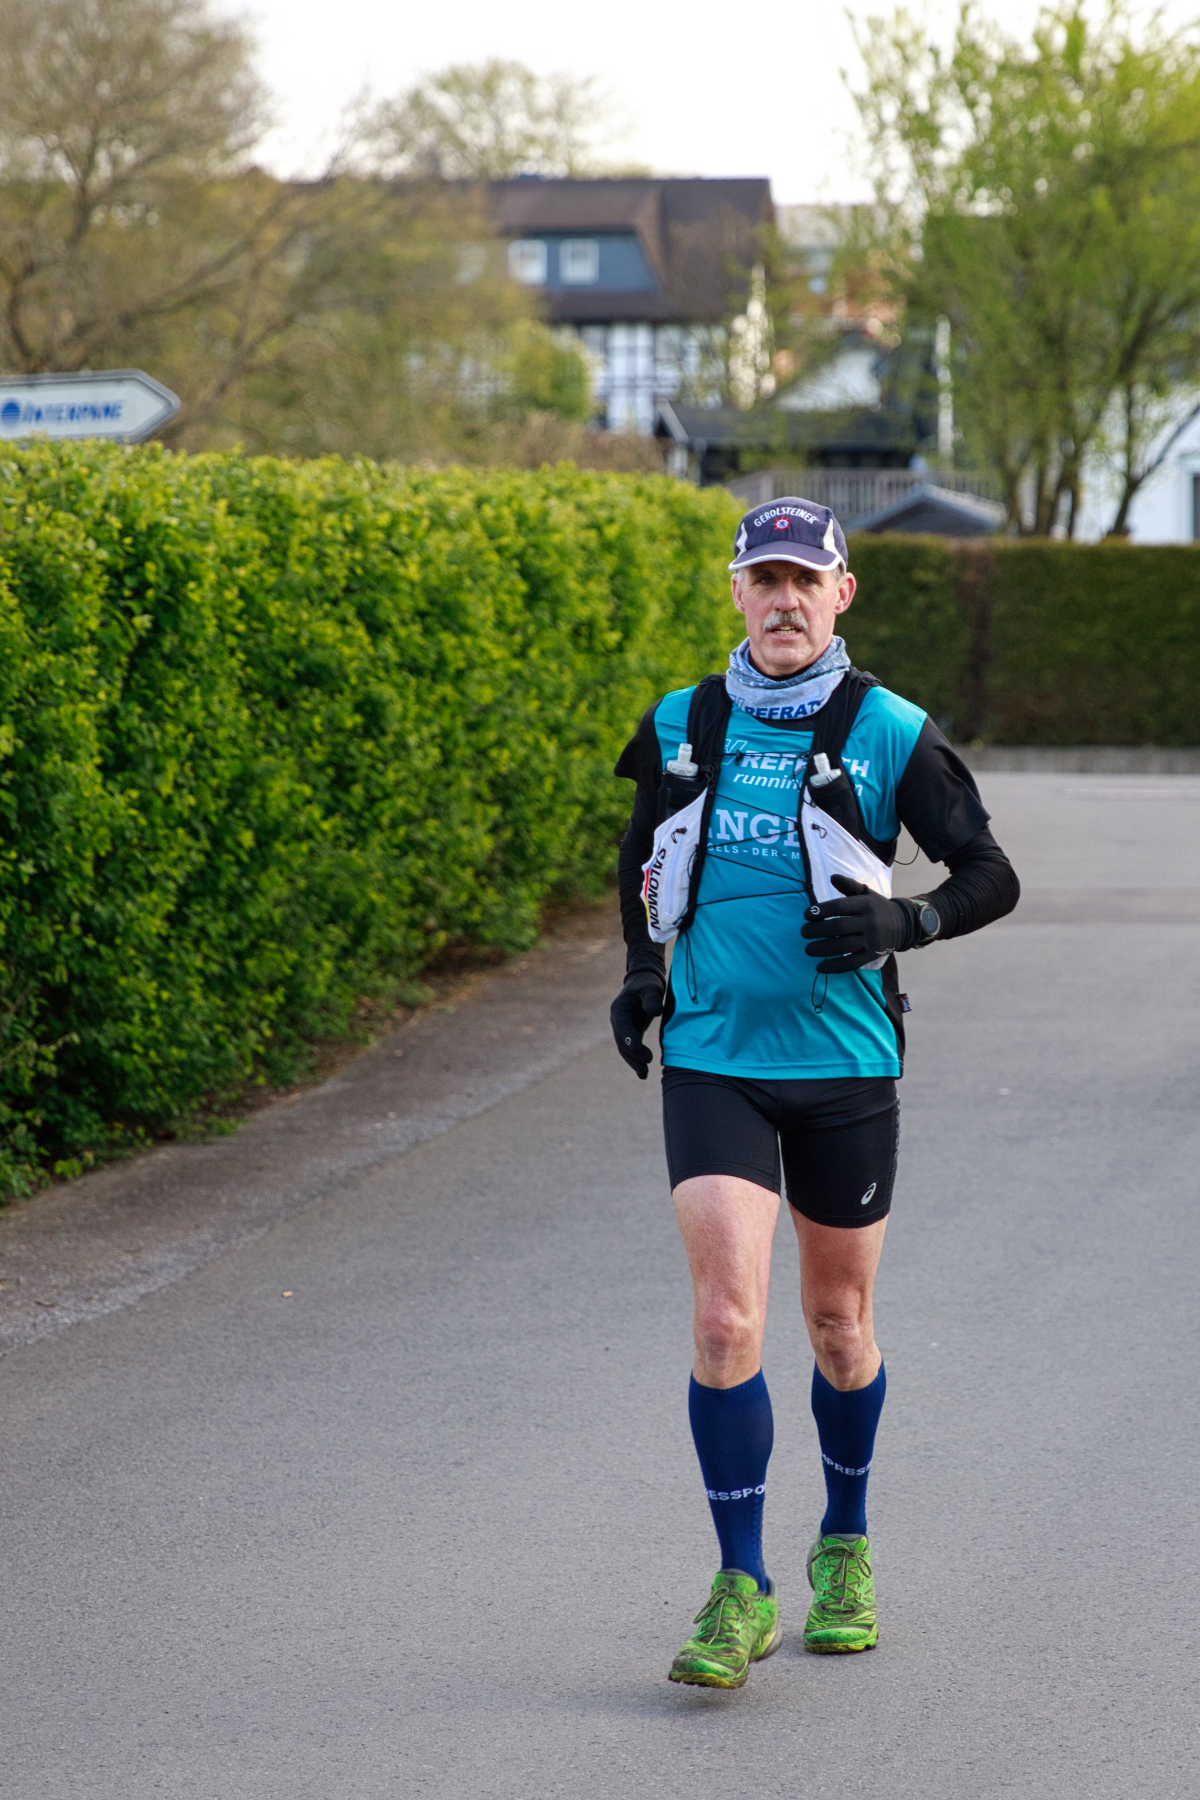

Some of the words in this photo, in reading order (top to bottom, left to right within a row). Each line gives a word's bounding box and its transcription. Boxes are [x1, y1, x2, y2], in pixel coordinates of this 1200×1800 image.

[753, 506, 817, 527] GEROLSTEINER
[733, 773, 802, 790] runnin
[647, 848, 667, 930] SALOMON
[705, 1483, 766, 1501] ESSPO
